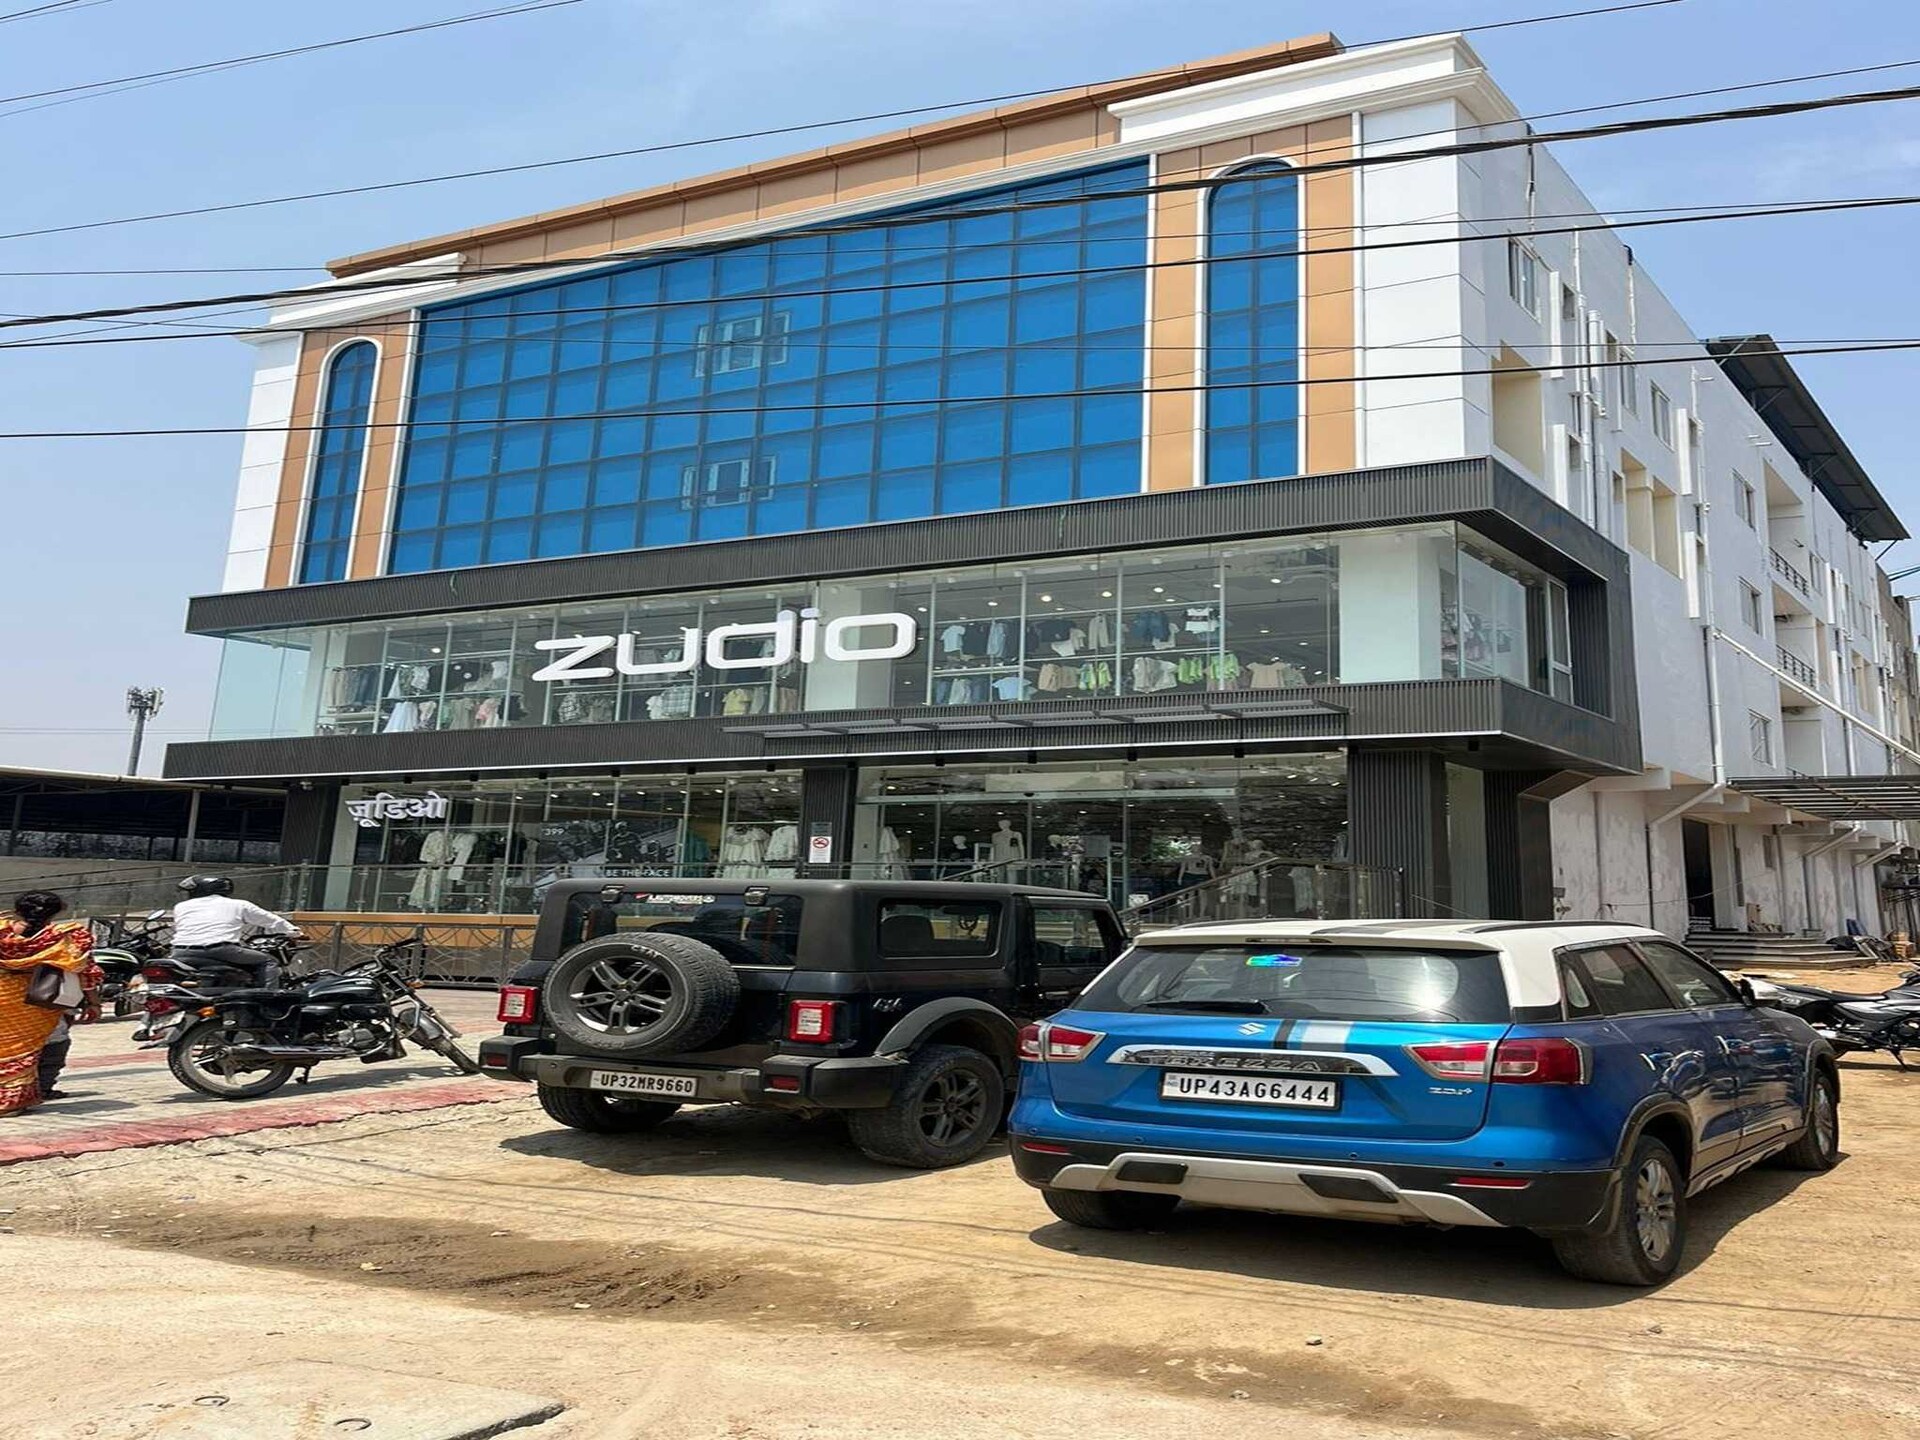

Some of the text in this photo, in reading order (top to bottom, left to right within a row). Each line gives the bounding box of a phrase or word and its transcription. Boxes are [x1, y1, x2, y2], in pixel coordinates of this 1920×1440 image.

[344, 790, 449, 828] ज़ूडिओ
[1164, 1055, 1322, 1073] BREZZA
[600, 1073, 693, 1093] UP32MR9660
[1179, 1077, 1330, 1102] UP43AG6444
